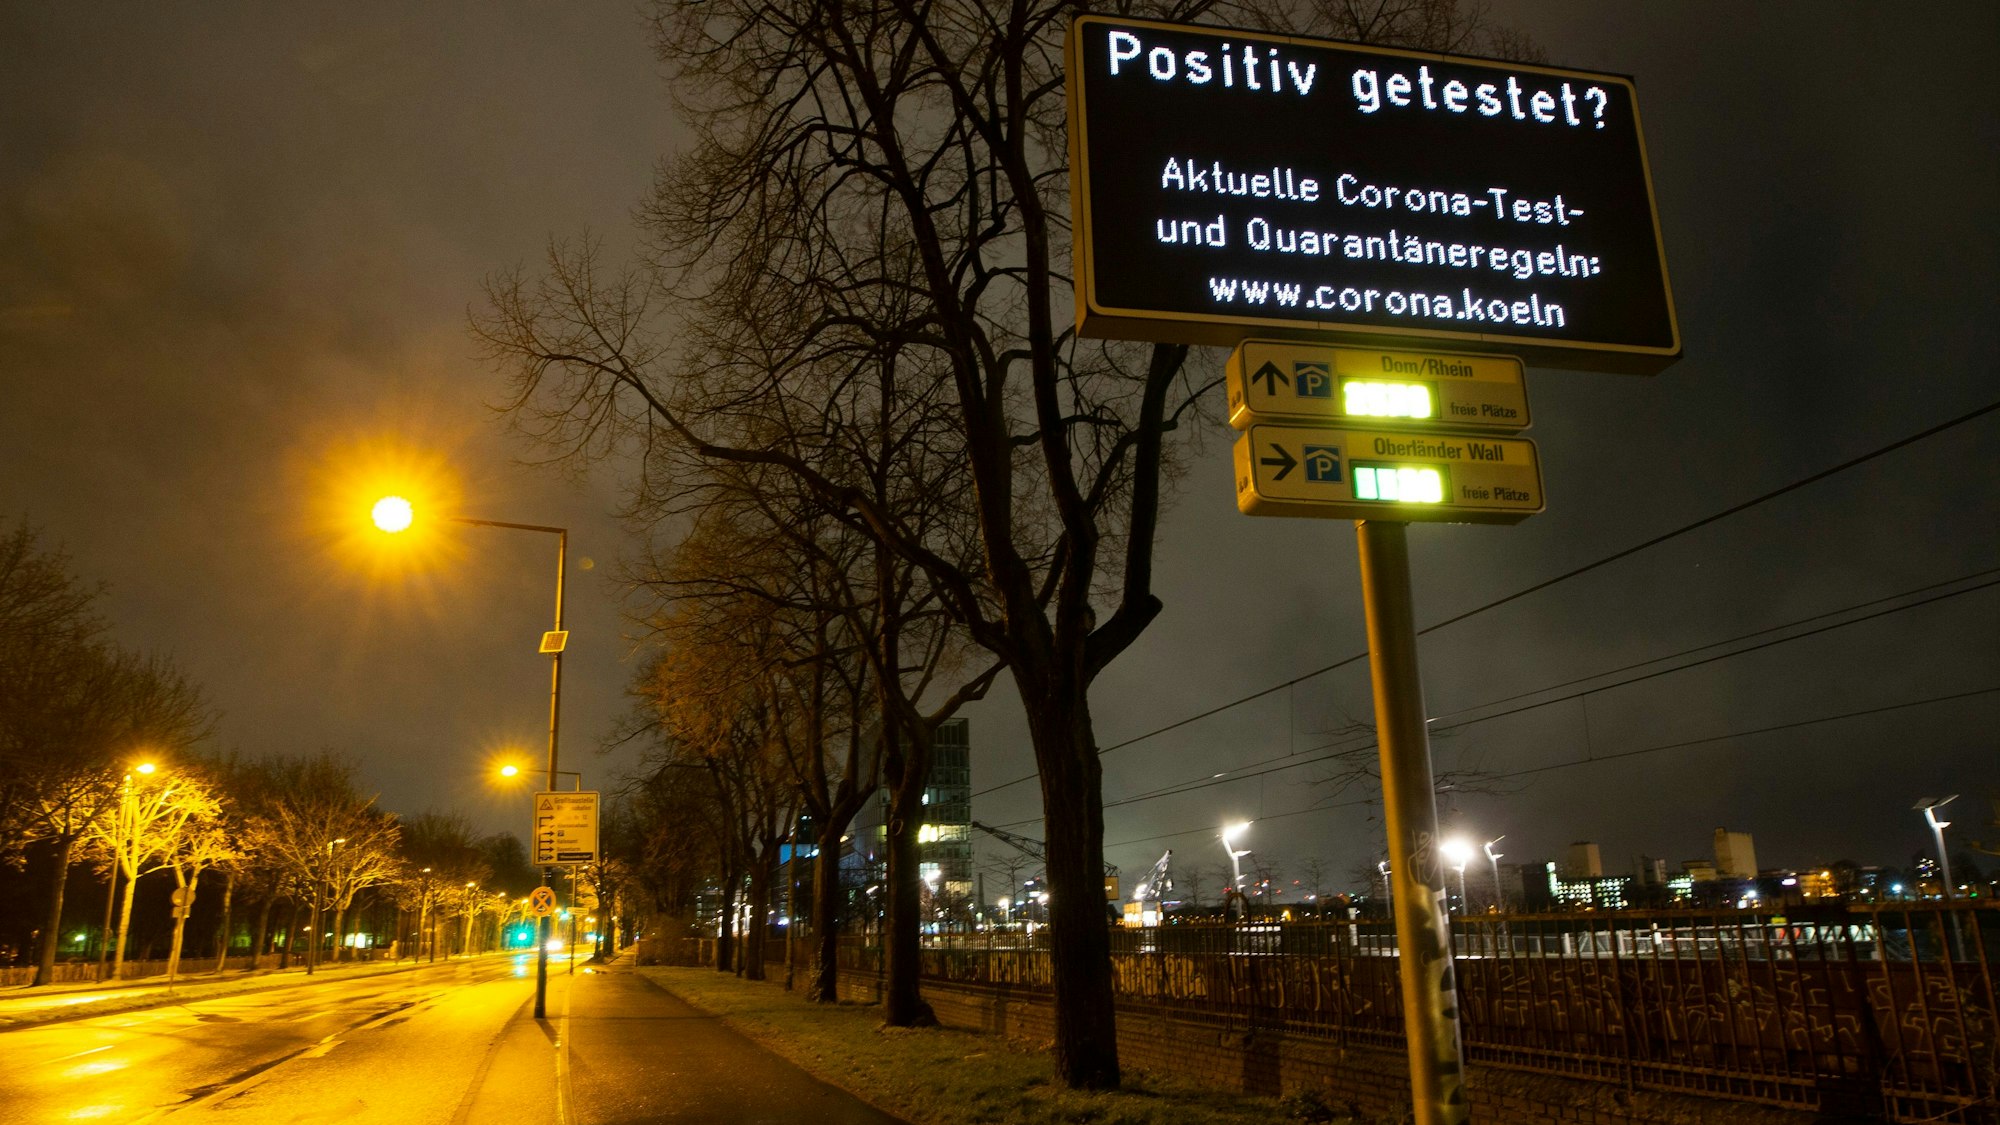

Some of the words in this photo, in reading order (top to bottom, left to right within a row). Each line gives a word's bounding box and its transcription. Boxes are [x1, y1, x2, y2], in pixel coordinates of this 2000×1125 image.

[1108, 30, 1317, 96] Positiv
[1351, 65, 1608, 129] getestet?
[1161, 156, 1320, 203] Aktuelle
[1336, 172, 1585, 226] Corona-Test-
[1156, 214, 1226, 248] und
[1246, 217, 1601, 280] Quarantäneregeln:
[1208, 276, 1566, 328] www.corona.koeln
[1381, 355, 1474, 378] Dom/Rhein
[1450, 402, 1478, 416] freie
[1481, 403, 1518, 418] Plätze
[1373, 437, 1463, 460] Oberländer
[1467, 442, 1505, 462] Wall
[1462, 485, 1490, 500] freie
[1493, 487, 1531, 502] Plätze
